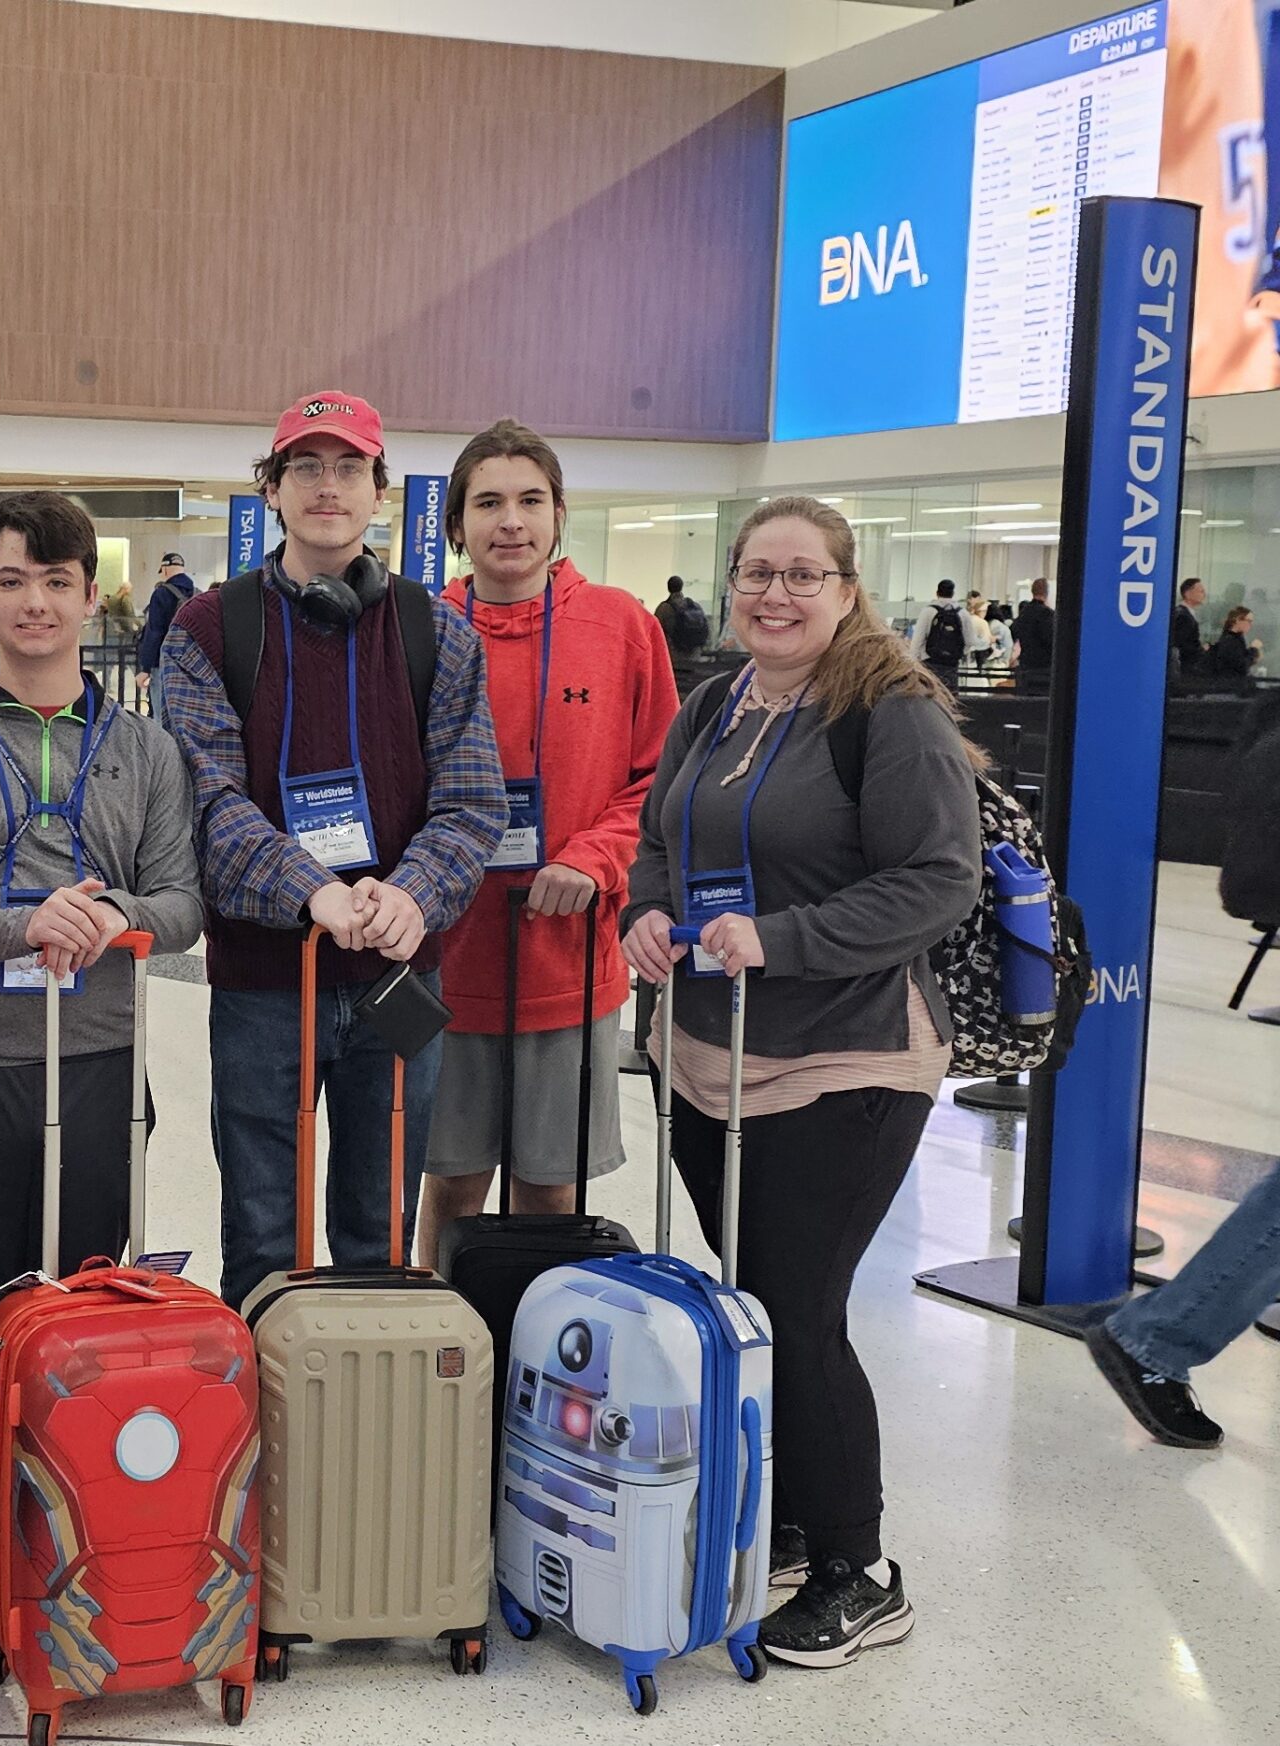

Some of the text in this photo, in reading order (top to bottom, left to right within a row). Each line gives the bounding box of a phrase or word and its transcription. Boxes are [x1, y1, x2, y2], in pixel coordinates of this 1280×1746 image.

[1068, 8, 1158, 55] DEPARTURE
[1117, 243, 1178, 628] STANDARD
[239, 507, 256, 562] TSA Pre
[425, 480, 439, 540] HONOR
[422, 542, 436, 585] LANE
[304, 785, 355, 802] WorldStrides
